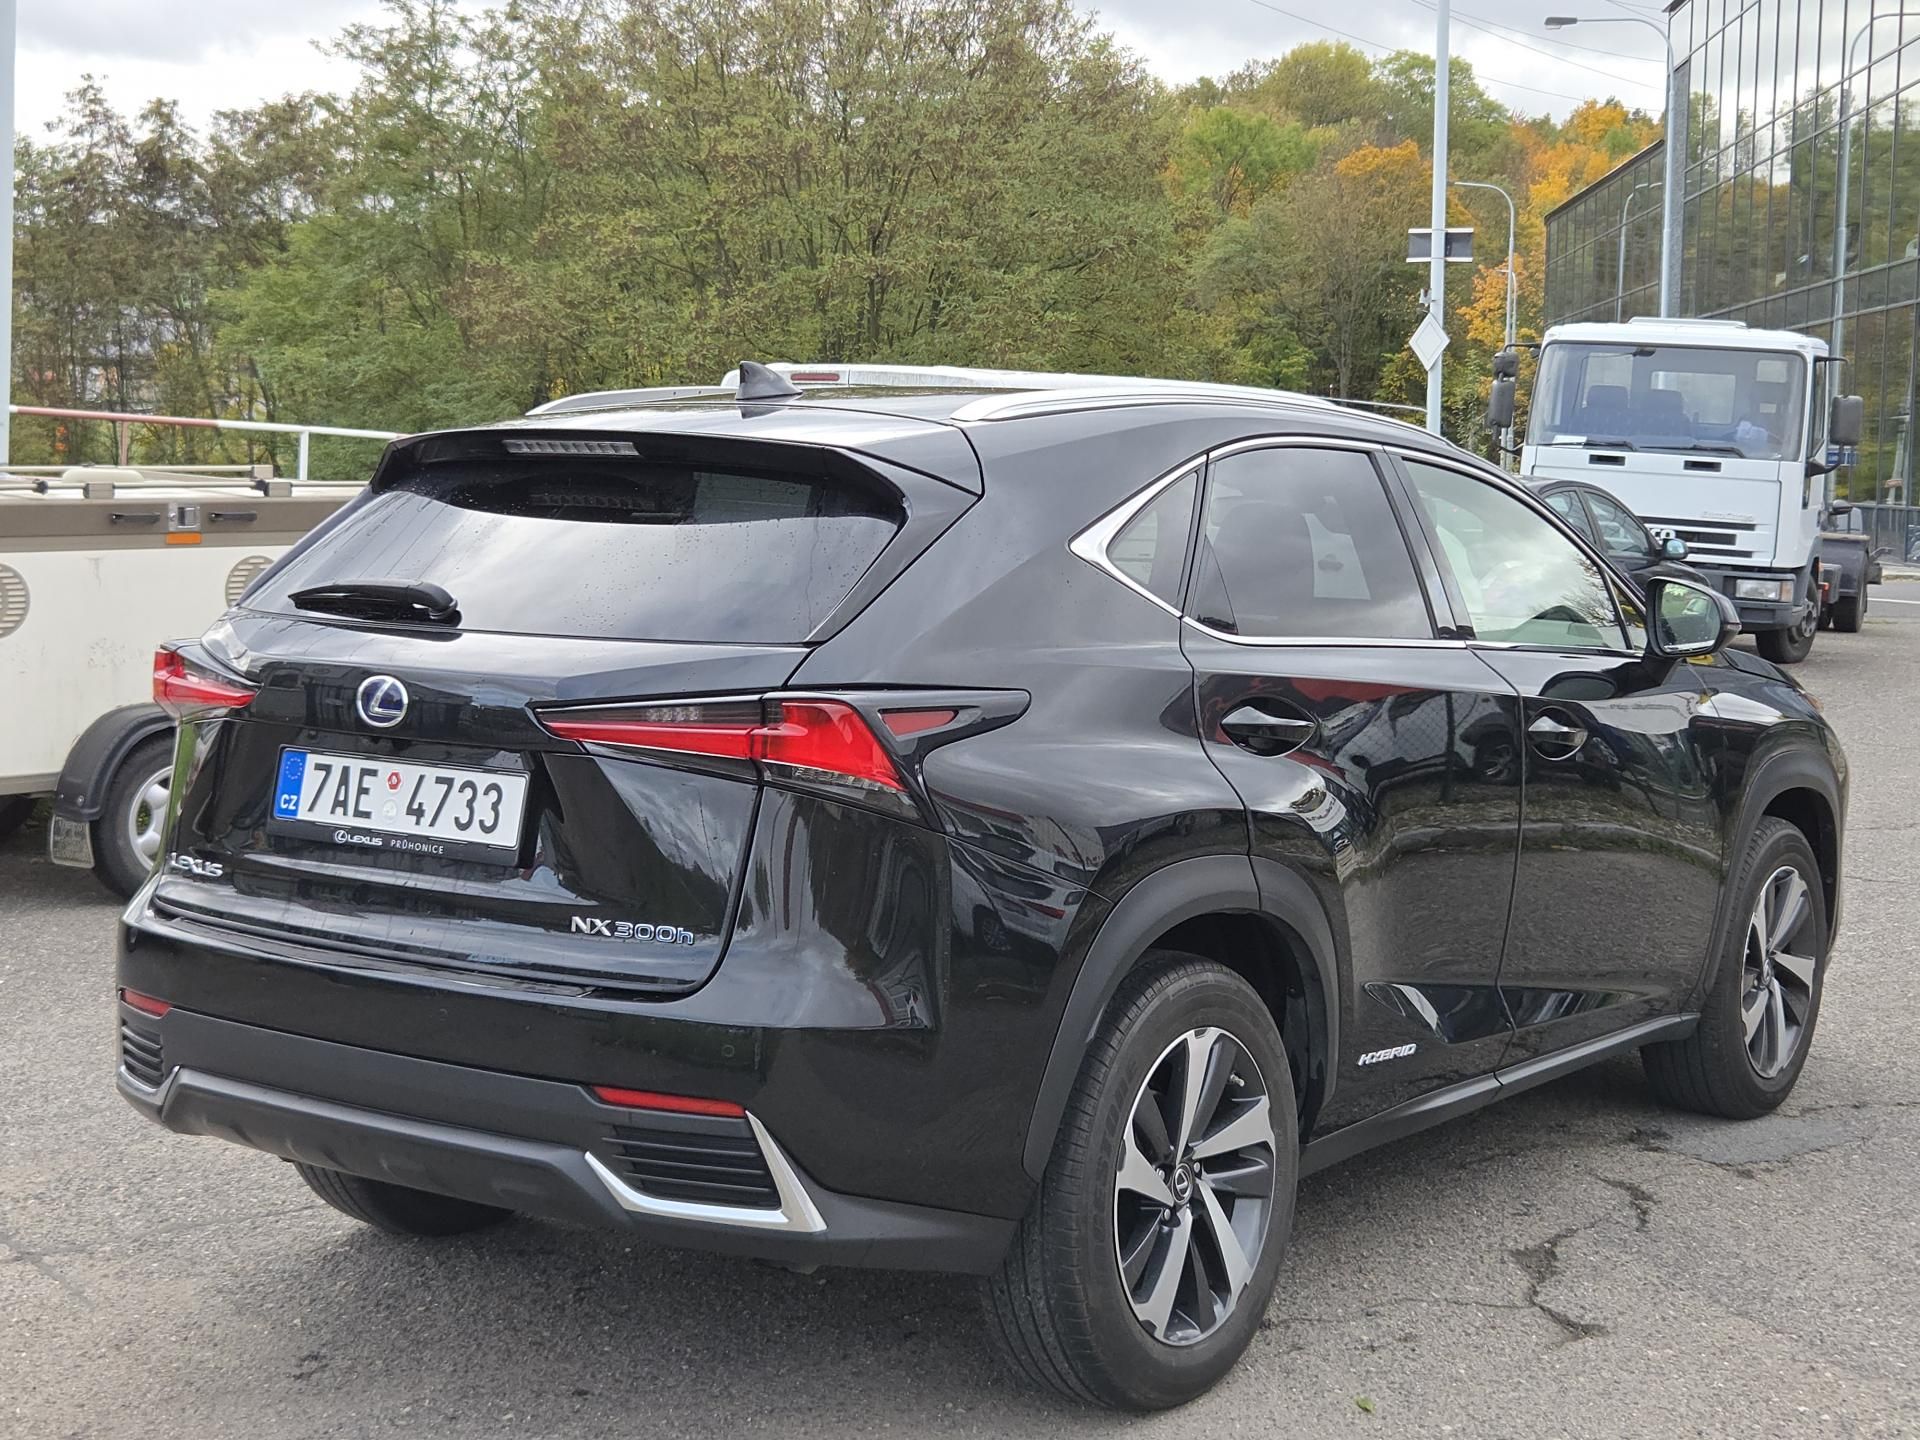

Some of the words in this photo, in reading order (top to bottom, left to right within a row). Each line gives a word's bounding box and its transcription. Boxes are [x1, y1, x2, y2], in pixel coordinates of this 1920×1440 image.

[280, 793, 298, 810] CZ
[307, 762, 378, 819] 7AE
[405, 774, 503, 834] 4733
[347, 834, 383, 846] LEXUS
[1357, 1043, 1417, 1066] HYBRID
